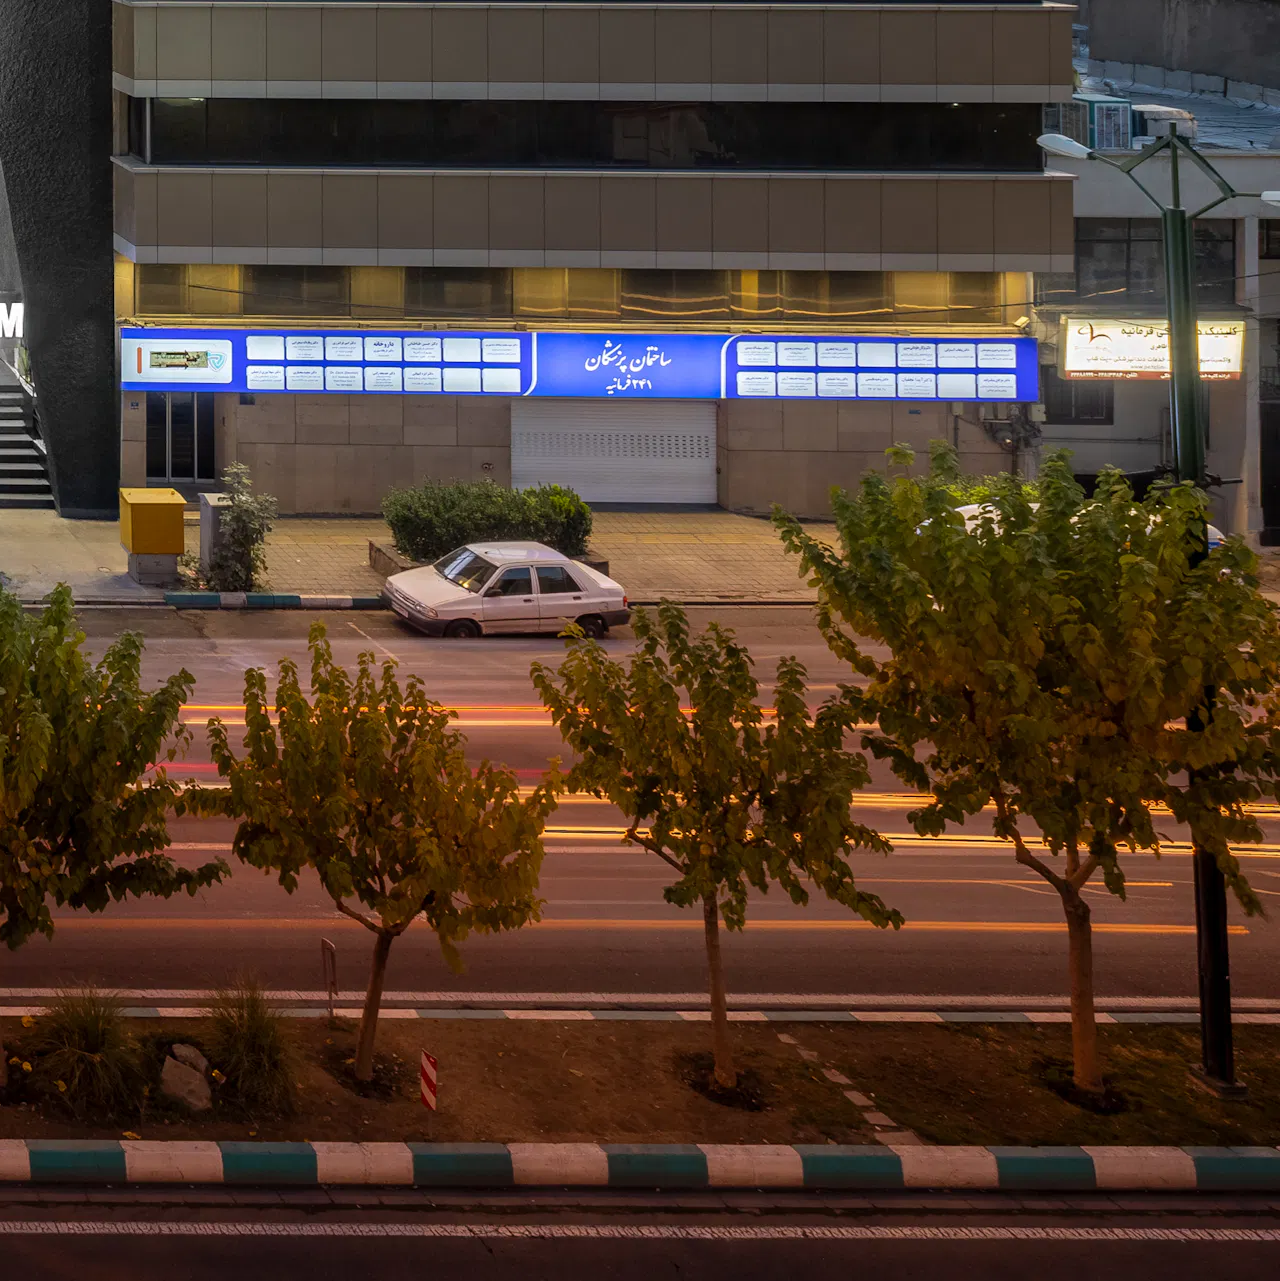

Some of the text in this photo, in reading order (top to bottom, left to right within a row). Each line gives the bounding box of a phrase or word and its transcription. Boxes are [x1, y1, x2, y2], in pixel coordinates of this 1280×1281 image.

[1121, 327, 1154, 337] فرمانیه
[1205, 326, 1237, 338] کلینیک
[584, 339, 672, 373] ساختمان پزشکان
[605, 373, 632, 395] فرمانیه
